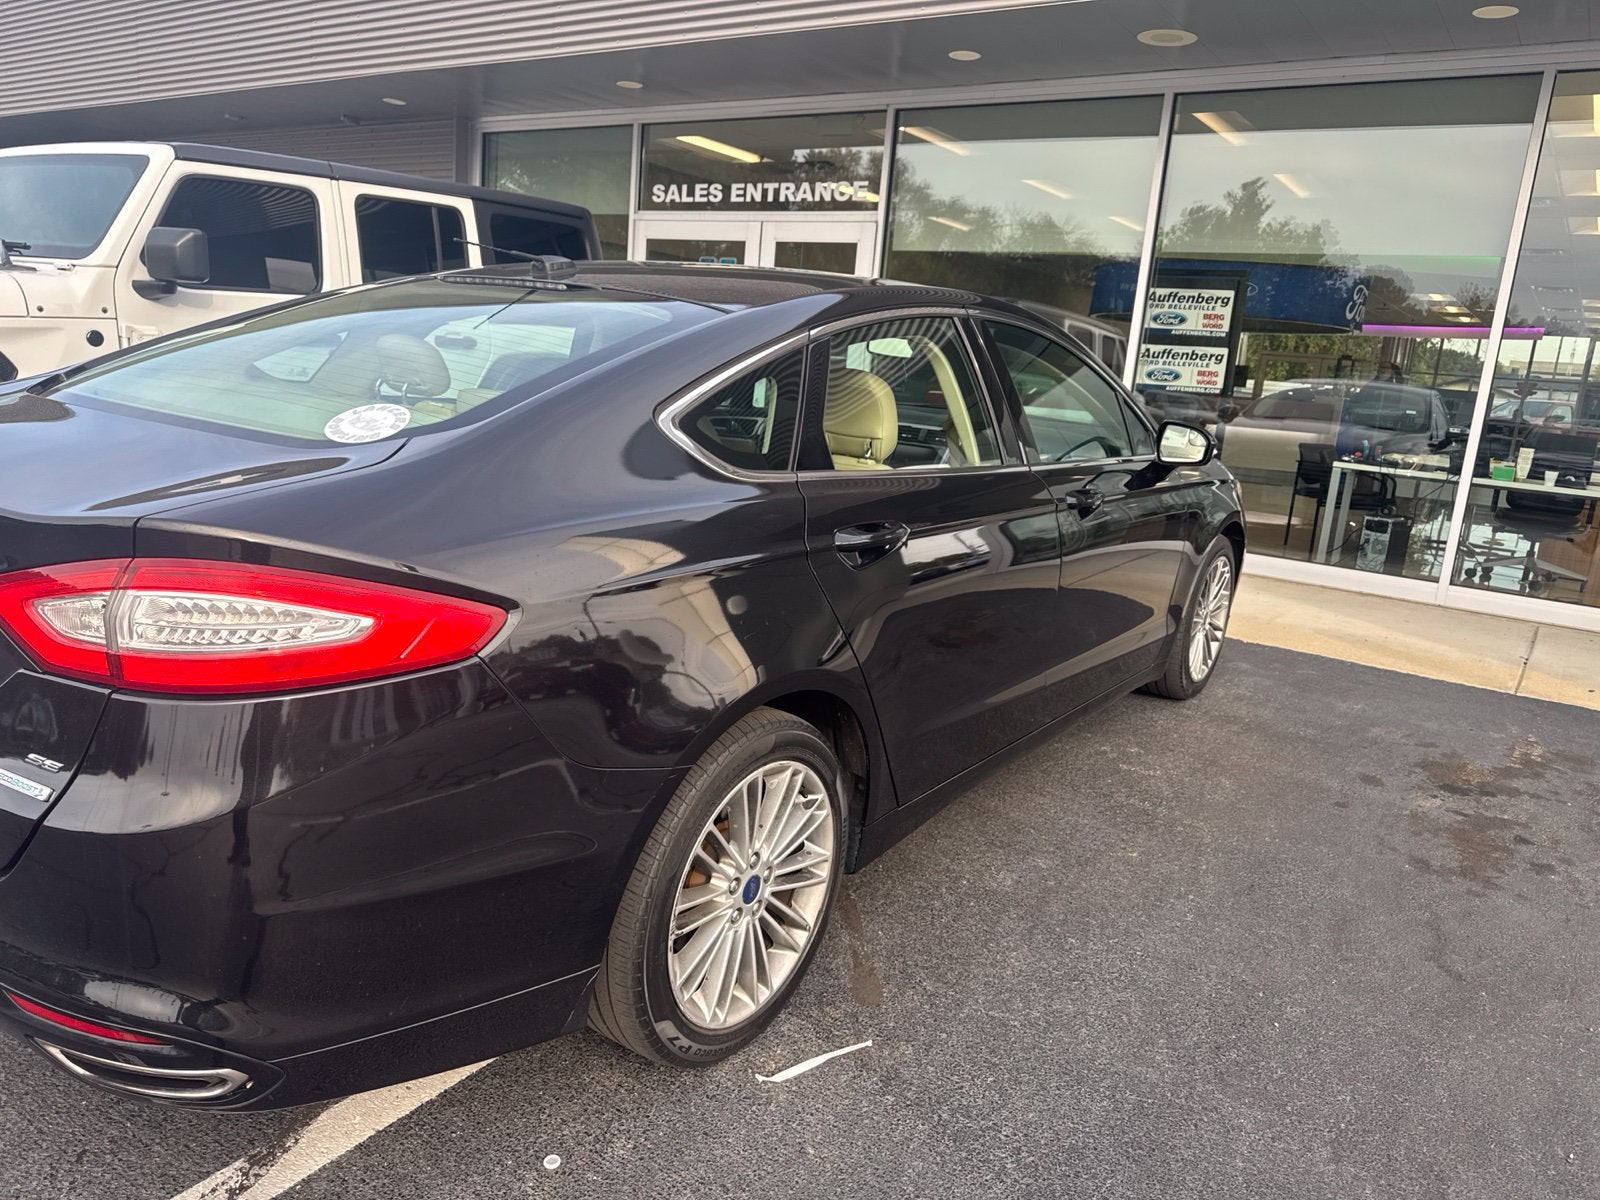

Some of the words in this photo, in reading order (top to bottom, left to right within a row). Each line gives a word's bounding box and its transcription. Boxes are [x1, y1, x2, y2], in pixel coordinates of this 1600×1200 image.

[652, 183, 723, 203] SALES
[730, 180, 869, 203] ENTRANCE
[1148, 291, 1231, 308] Auffenberg
[1168, 303, 1217, 312] BELLEVILLE
[1155, 312, 1182, 326] Ford
[1203, 313, 1225, 321] BERG
[1171, 329, 1227, 338] AUFFENBERG.COM
[1141, 348, 1225, 365] Auffenberg
[1162, 360, 1211, 369] BELLEVILLE
[1149, 369, 1176, 382] Ford
[1197, 370, 1219, 378] BERG
[1196, 379, 1218, 387] WORD
[1165, 386, 1220, 394] AUFFENBERG.COM
[25, 753, 65, 773] SE
[666, 1036, 692, 1055] P7
